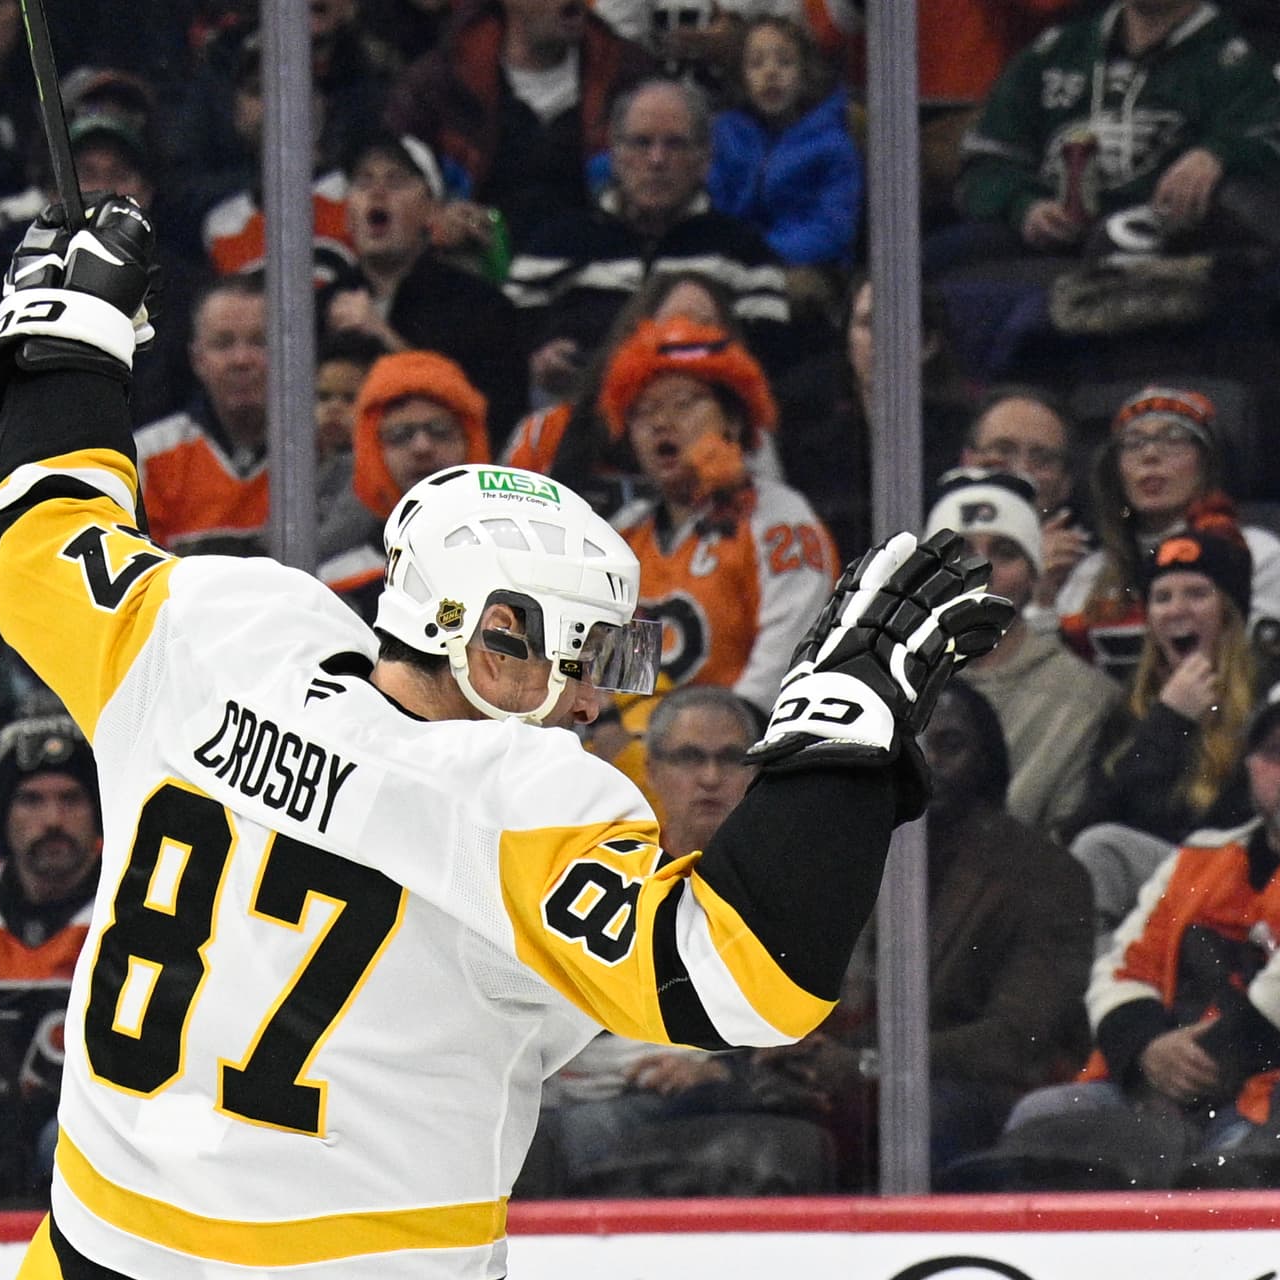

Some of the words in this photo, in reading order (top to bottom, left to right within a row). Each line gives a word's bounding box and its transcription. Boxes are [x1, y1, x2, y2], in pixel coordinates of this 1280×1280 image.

[482, 472, 556, 500] MSA
[61, 523, 172, 612] 7
[193, 699, 358, 834] CROSBY
[83, 777, 410, 1138] 87
